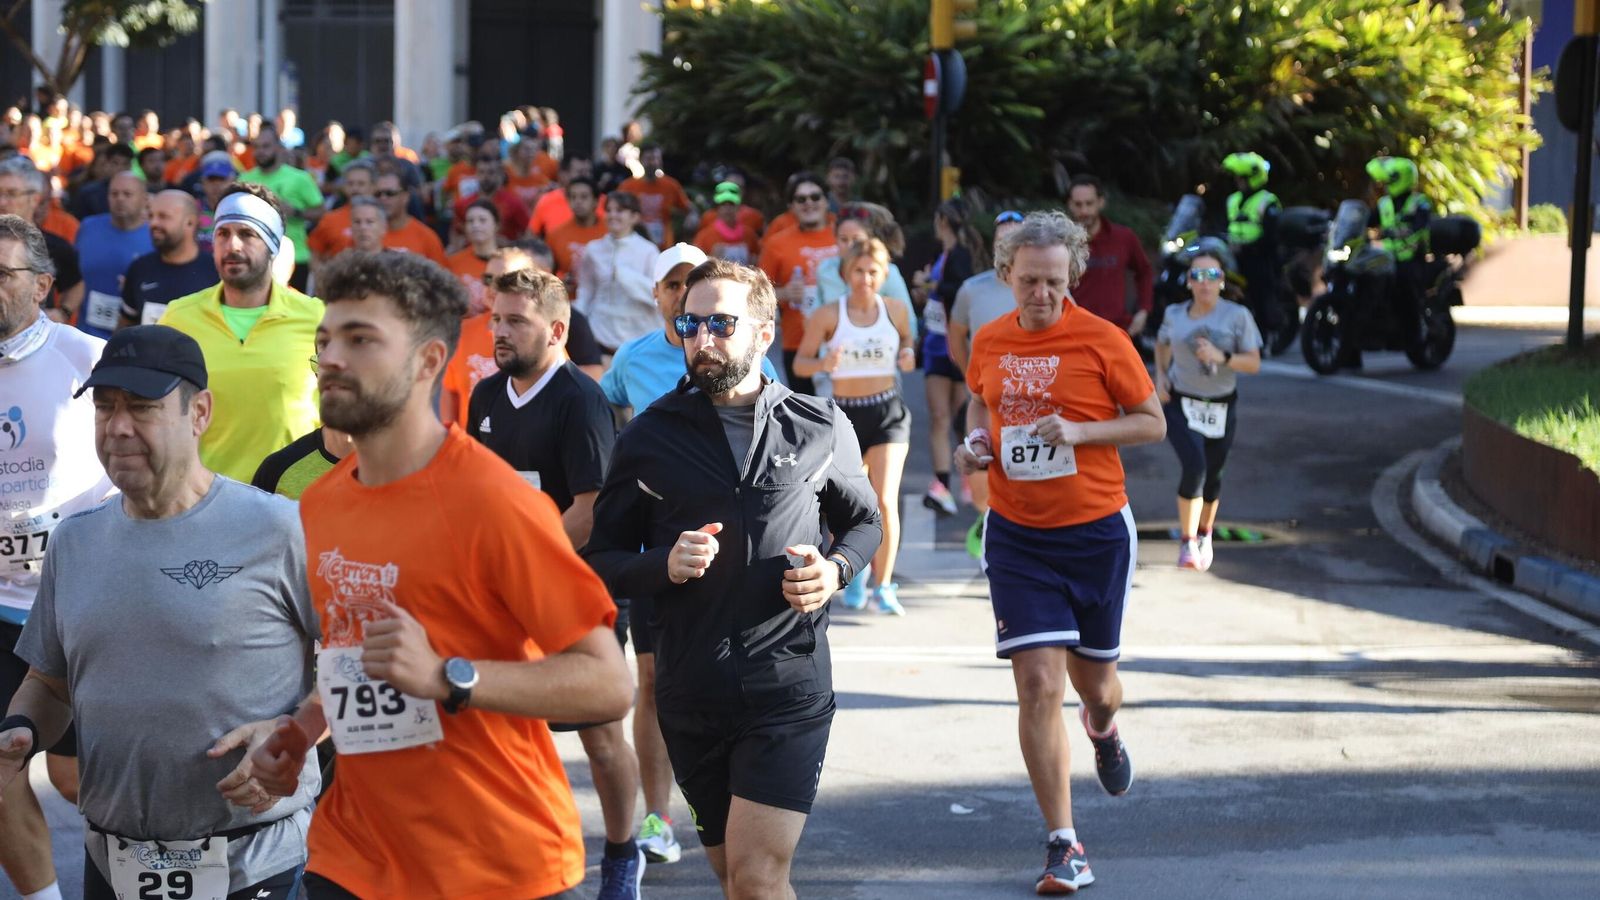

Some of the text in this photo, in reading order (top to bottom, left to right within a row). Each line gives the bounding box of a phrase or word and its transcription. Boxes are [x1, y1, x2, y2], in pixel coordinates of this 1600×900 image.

[1011, 443, 1057, 464] 877
[0, 530, 49, 556] 377
[330, 682, 406, 721] 793
[138, 869, 194, 900] 29
